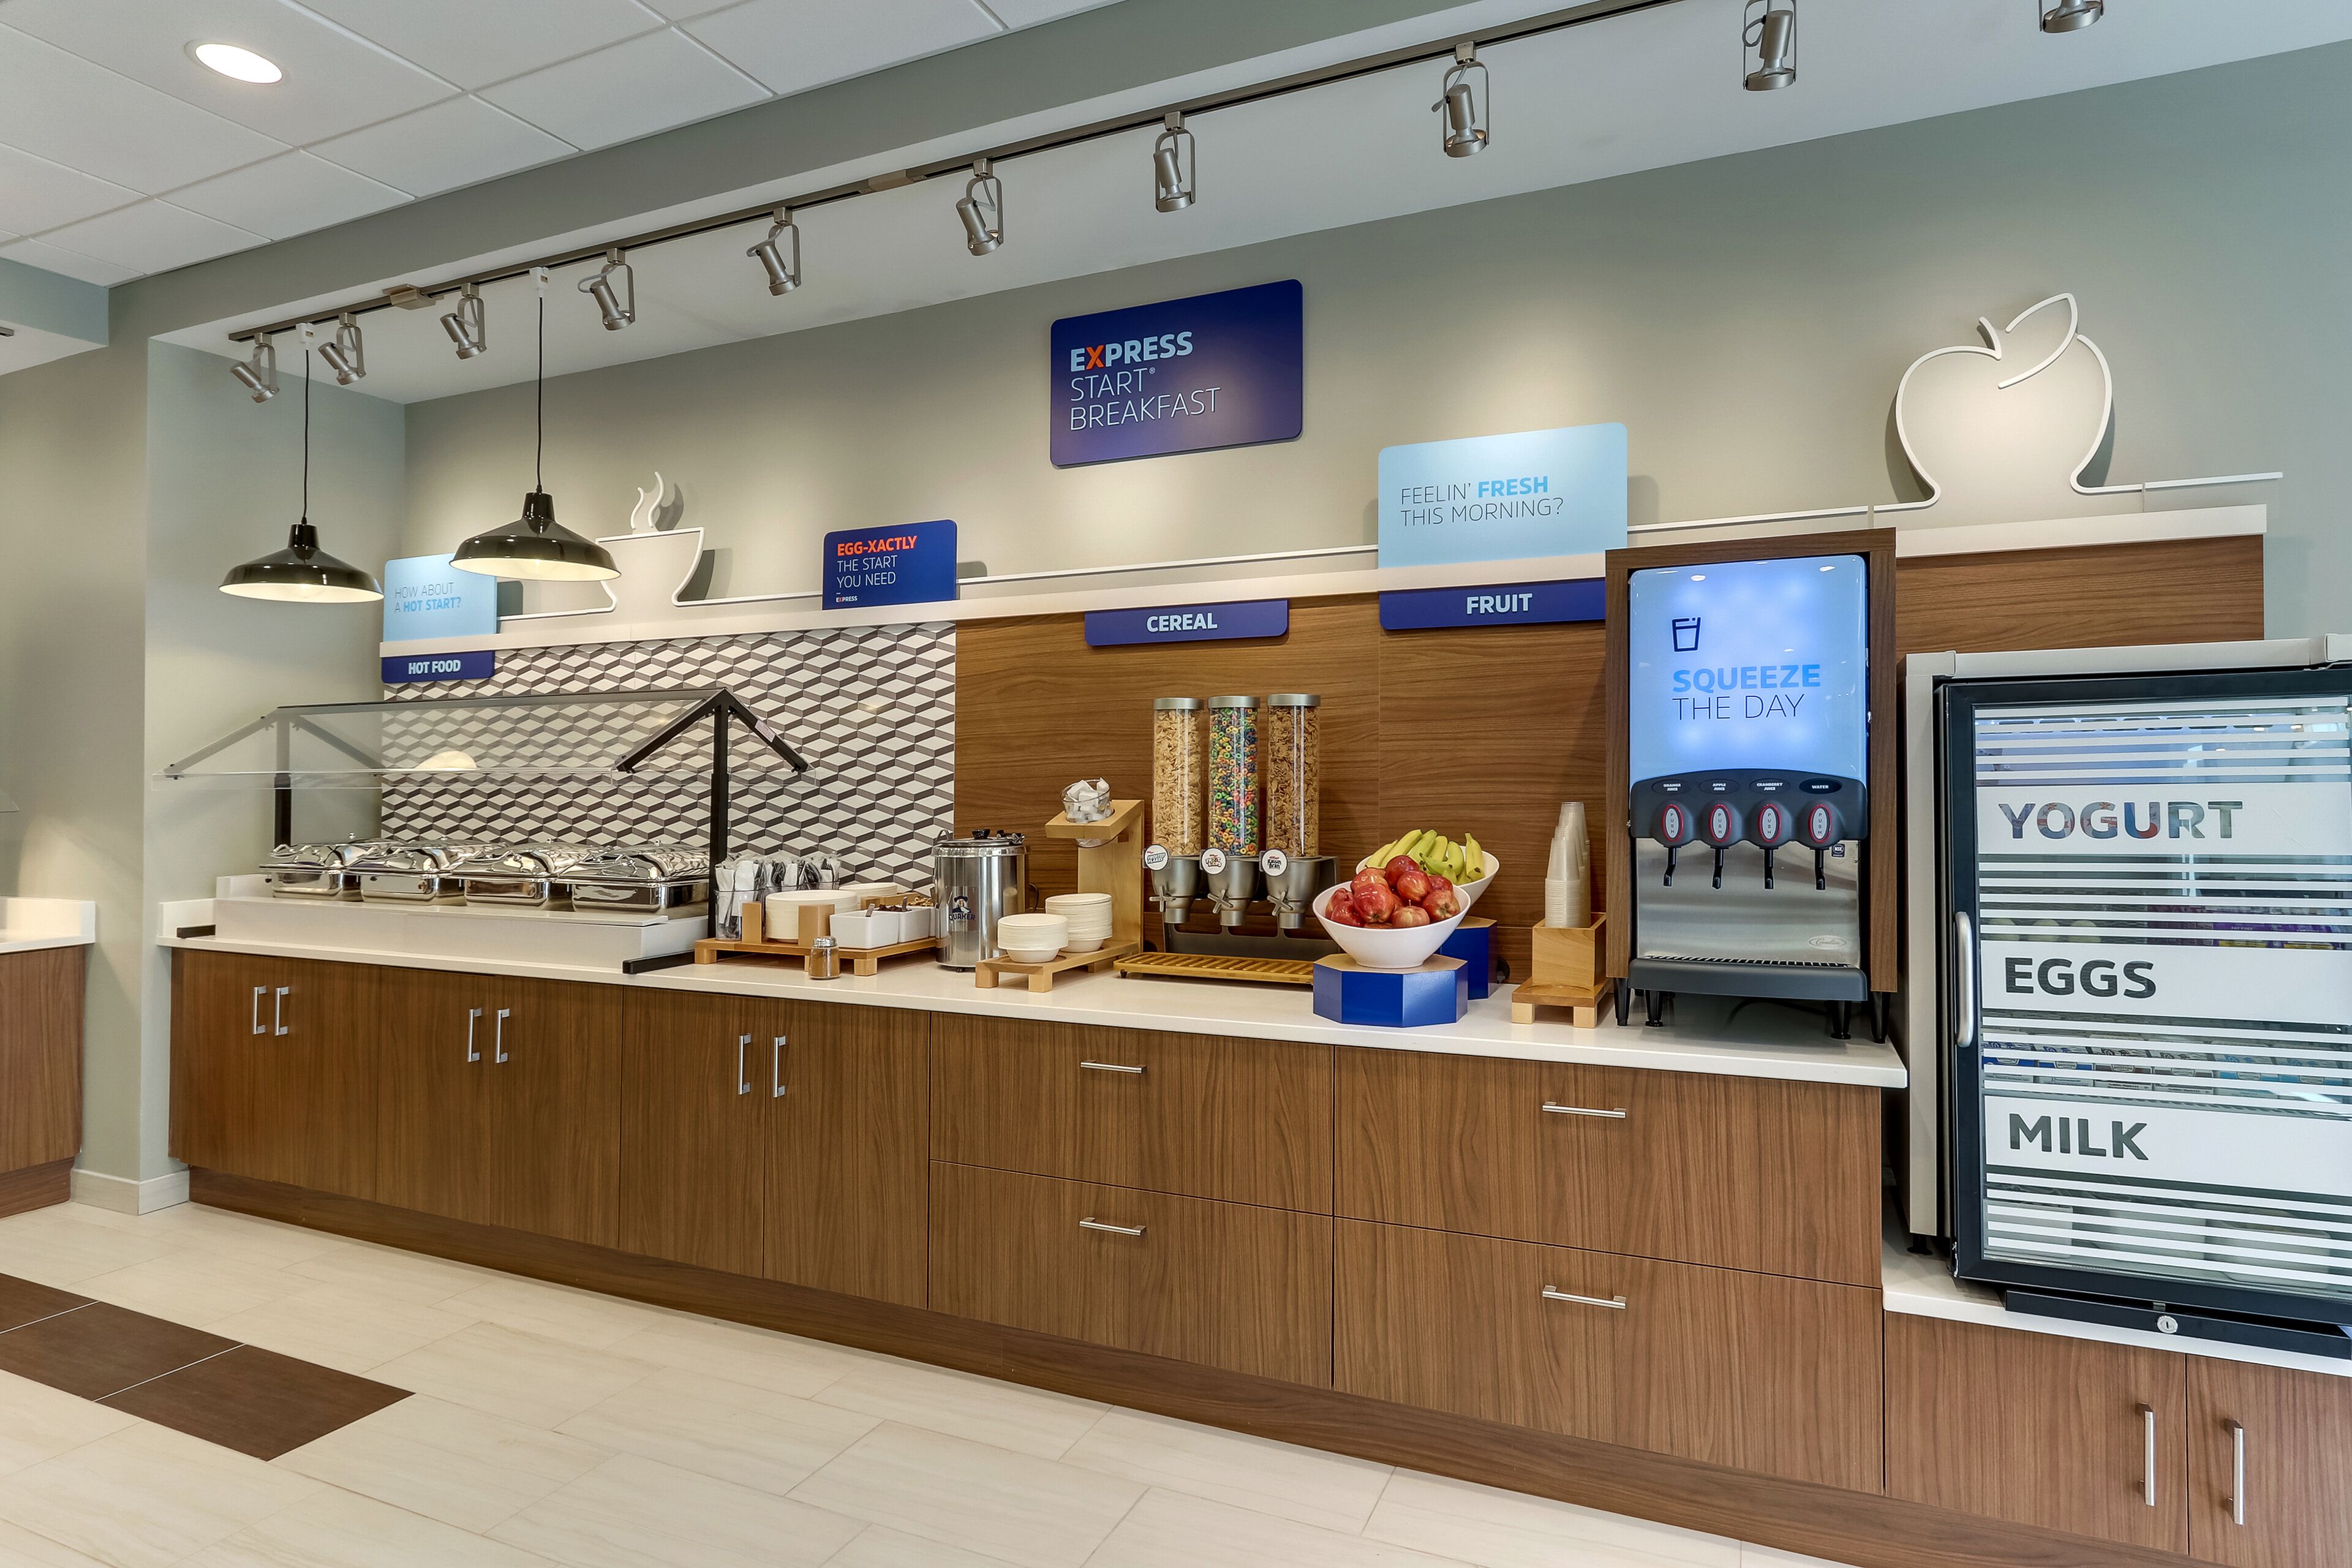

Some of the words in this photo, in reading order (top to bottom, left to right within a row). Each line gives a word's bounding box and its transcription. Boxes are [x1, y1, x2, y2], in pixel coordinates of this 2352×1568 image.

[1071, 331, 1194, 372] EXPRESS
[1071, 386, 1221, 431] BREAKFAST
[1478, 475, 1548, 498] FRESH
[1400, 507, 1444, 527] THIS
[1451, 497, 1564, 523] MORNING?
[837, 535, 917, 556] EGG-XACTLY
[837, 559, 859, 573] THE
[862, 555, 897, 570] START
[395, 586, 418, 598] HOW
[421, 582, 454, 596] ABOUT
[837, 575, 861, 589] YOU
[865, 571, 896, 586] NEED
[394, 603, 401, 612] A
[403, 600, 423, 612] HOT
[426, 597, 461, 610] START?
[1466, 593, 1533, 614] FRUIT
[1147, 612, 1218, 632] CEREAL
[409, 662, 430, 674] HOT
[431, 659, 461, 673] FOOD
[1672, 664, 1821, 693] SQUEEZE
[1672, 696, 1731, 720] THE
[1744, 693, 1805, 719] DAY
[1998, 801, 2243, 839] YOGURT
[2005, 957, 2156, 998] EGGS
[2010, 1113, 2149, 1160] MILK
